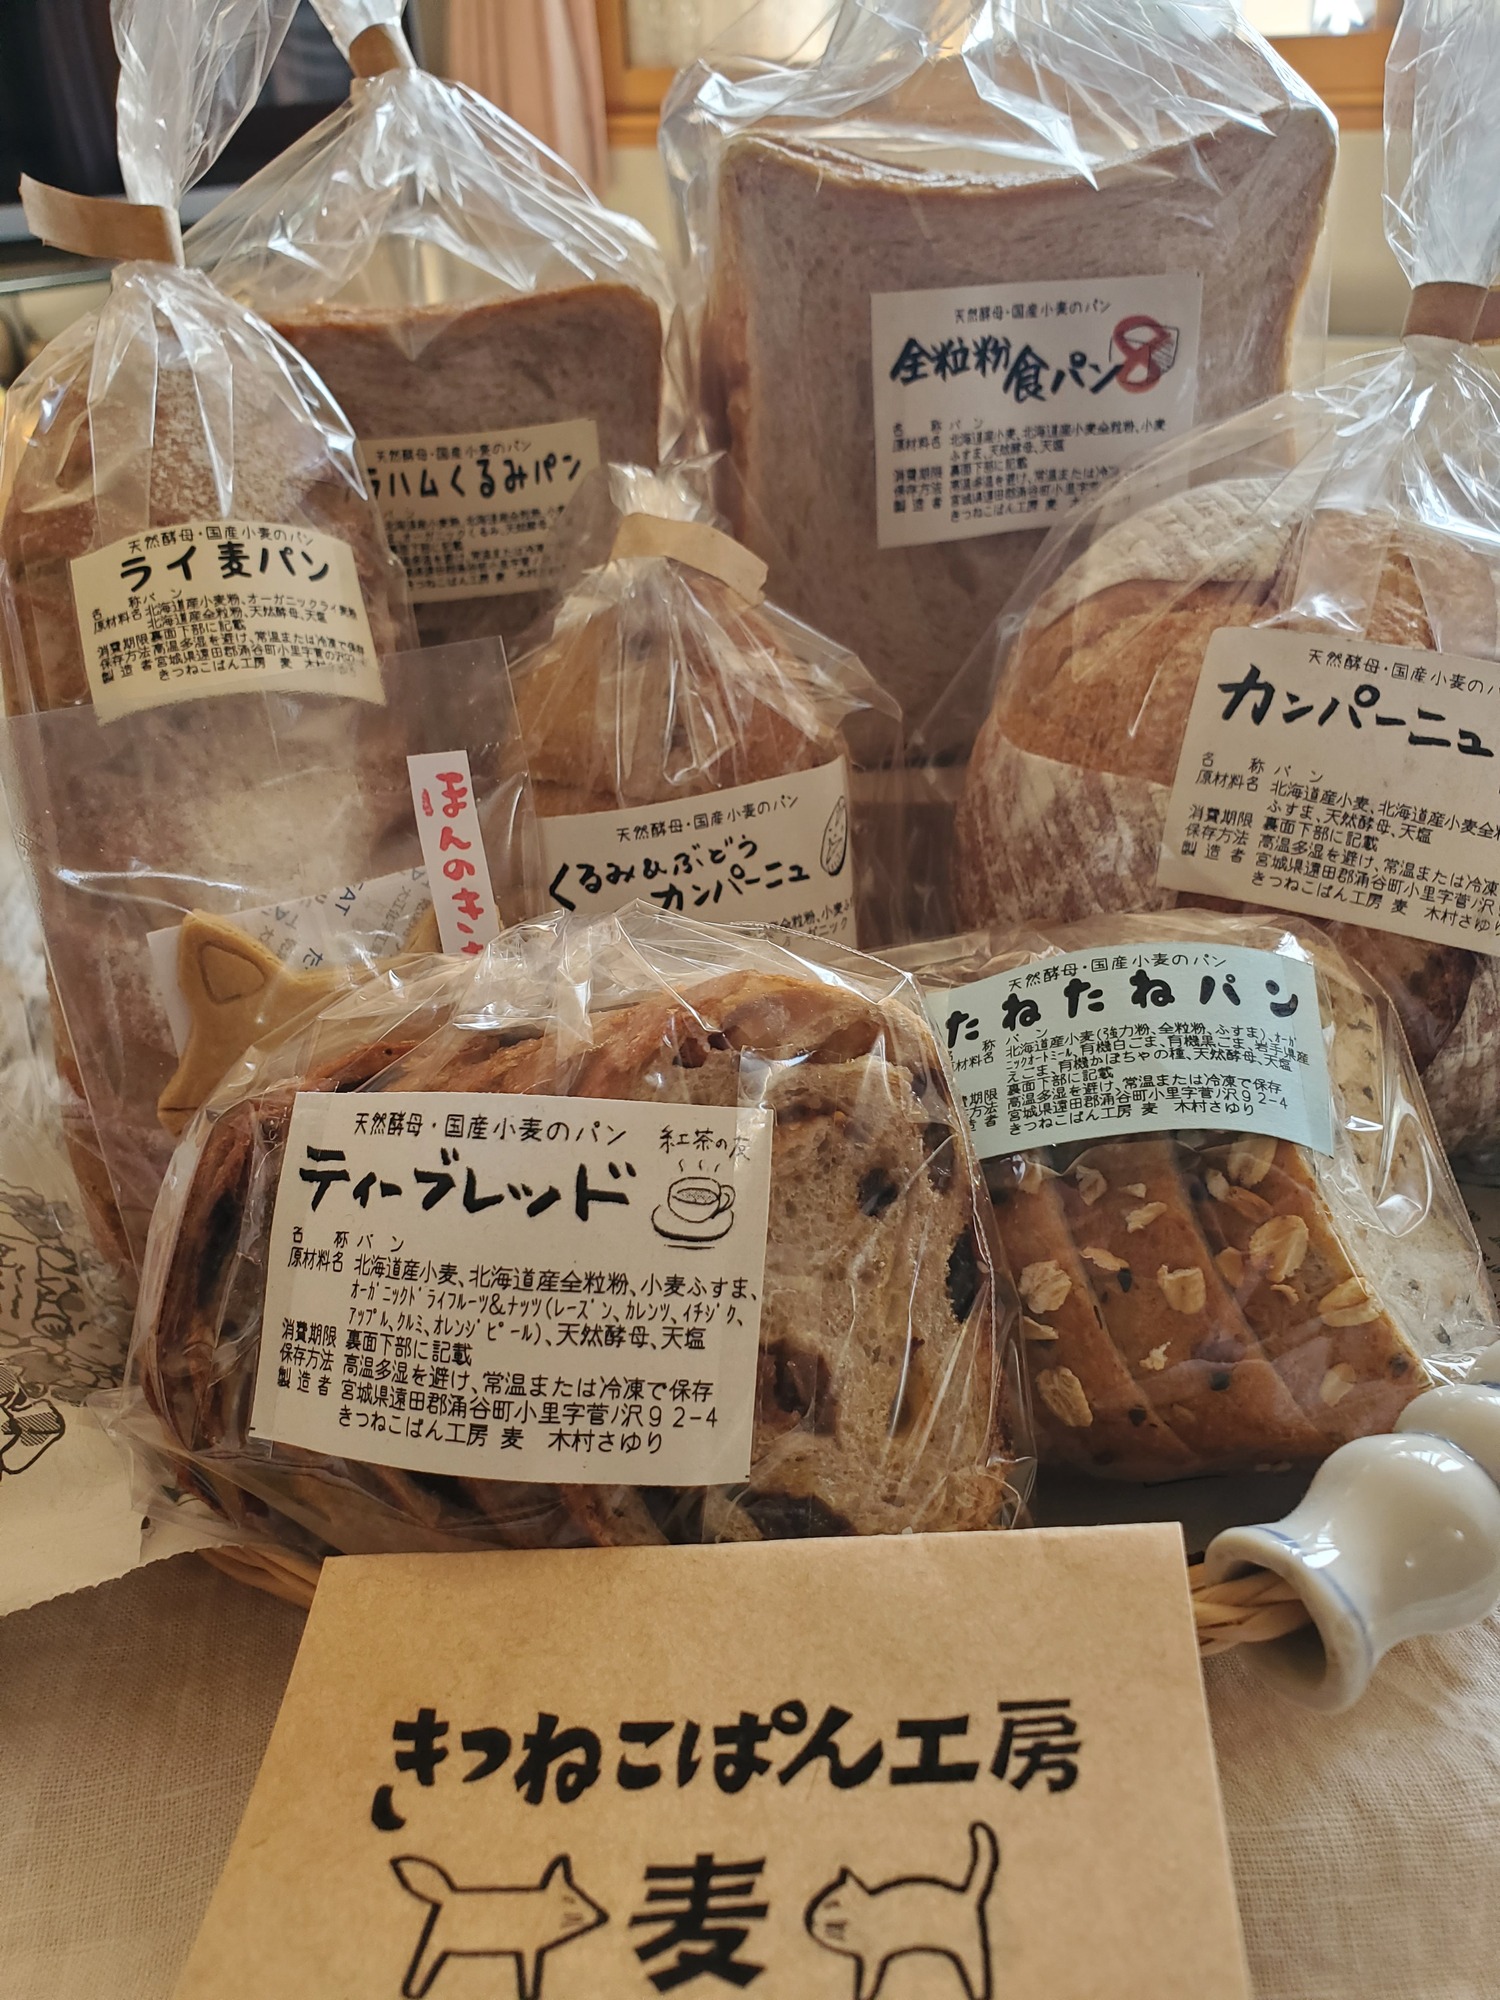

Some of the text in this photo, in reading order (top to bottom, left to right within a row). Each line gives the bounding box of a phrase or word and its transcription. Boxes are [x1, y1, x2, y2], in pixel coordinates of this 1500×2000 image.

[890, 335, 1124, 402] 全粒粉食パン
[128, 525, 315, 554] 天然酵母・国産小麦のパン
[120, 541, 330, 592] ライ麦パン
[1217, 663, 1495, 757] カンパーニュ
[1195, 769, 1259, 793] 原材料名
[617, 795, 798, 842] 天然酵母・国産小麦のパン
[1185, 823, 1249, 846] 保存方法
[1189, 804, 1253, 828] 消費期限
[651, 861, 810, 912] カンパーニュ
[1008, 952, 1227, 991] 天然酵母・国産小麦のパン
[946, 968, 1300, 1049] たねたねパン
[354, 1112, 627, 1146] 天然酵母・国産小麦のパン
[1175, 1100, 1254, 1116] 木村さゆり
[299, 1145, 636, 1221] ティーブレッド
[288, 1247, 343, 1273] 原材料名
[282, 1318, 473, 1367] 消費期限 裏面下部に記載
[279, 1342, 714, 1403] 保存方法 高温多湿を避け、常温または冷凍で保存
[548, 1428, 664, 1453] 木村さゆり
[370, 1698, 1085, 1831] きつねこぱん工房
[627, 1852, 770, 1994] 麦
